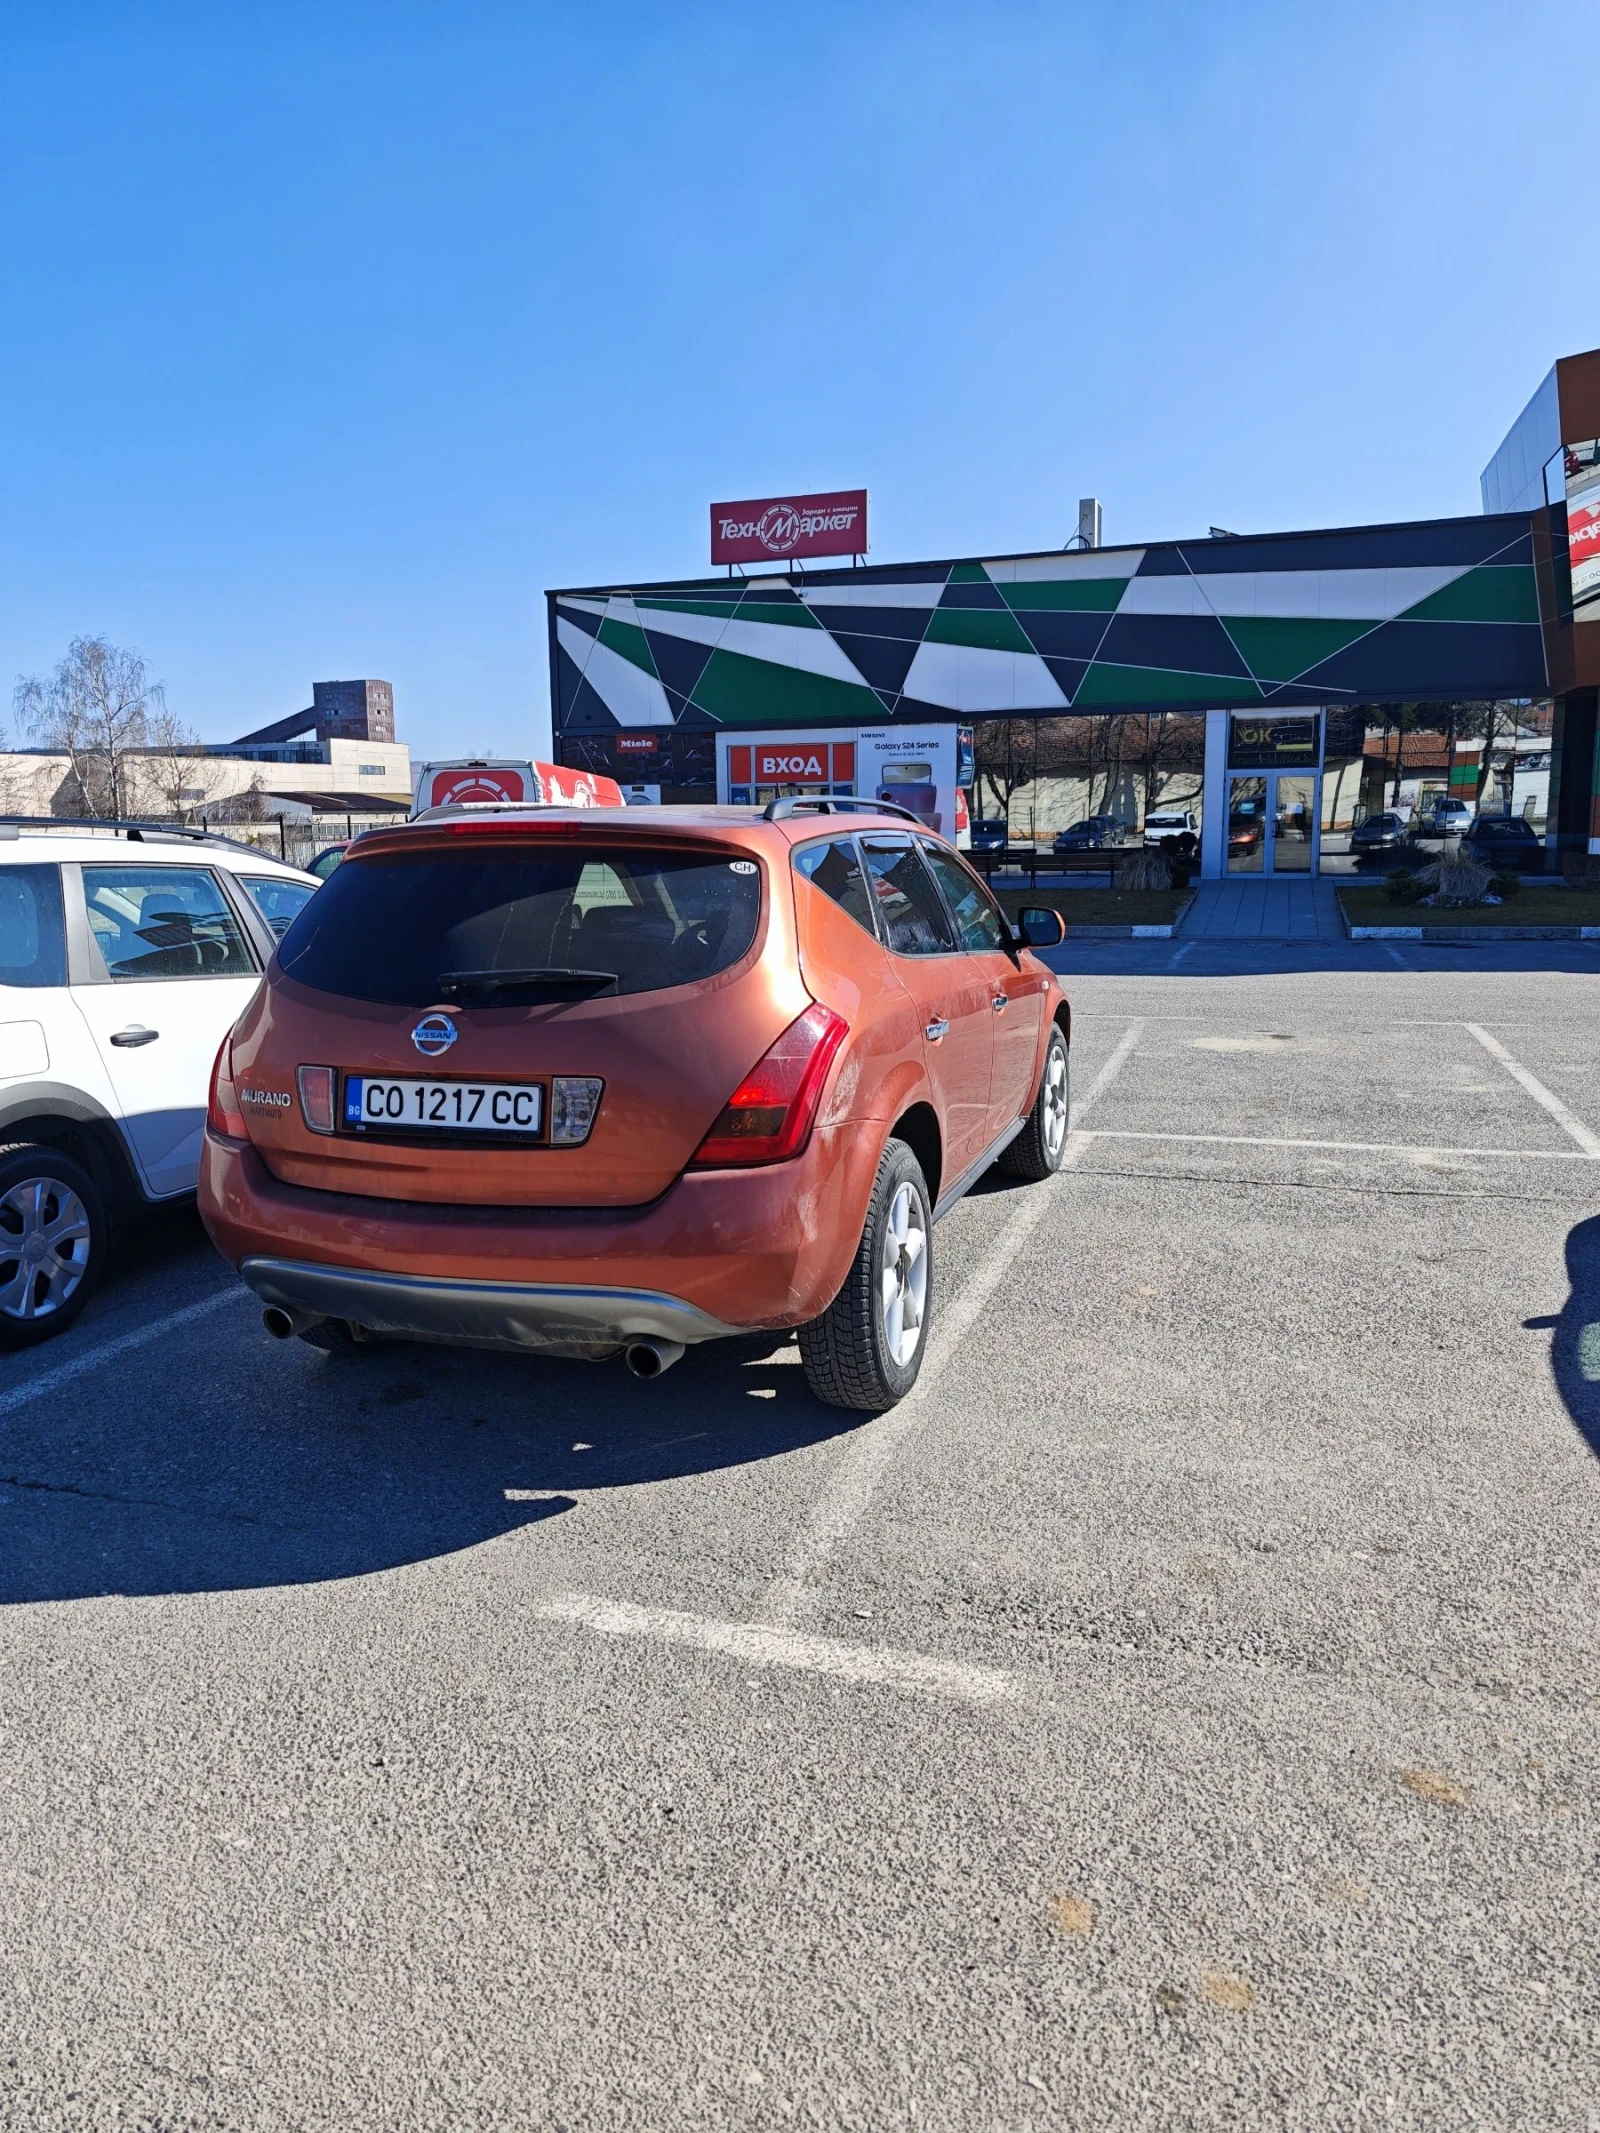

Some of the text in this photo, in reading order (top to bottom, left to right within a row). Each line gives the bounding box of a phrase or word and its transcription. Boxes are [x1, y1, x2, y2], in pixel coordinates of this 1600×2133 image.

[620, 739, 653, 748] Miele
[874, 740, 939, 751] Galaxy S24 Series
[762, 756, 822, 776] ВХОД
[734, 862, 752, 872] CH
[415, 1031, 452, 1040] NISSAN
[241, 1088, 292, 1107] MURANO
[348, 1105, 361, 1116] BG
